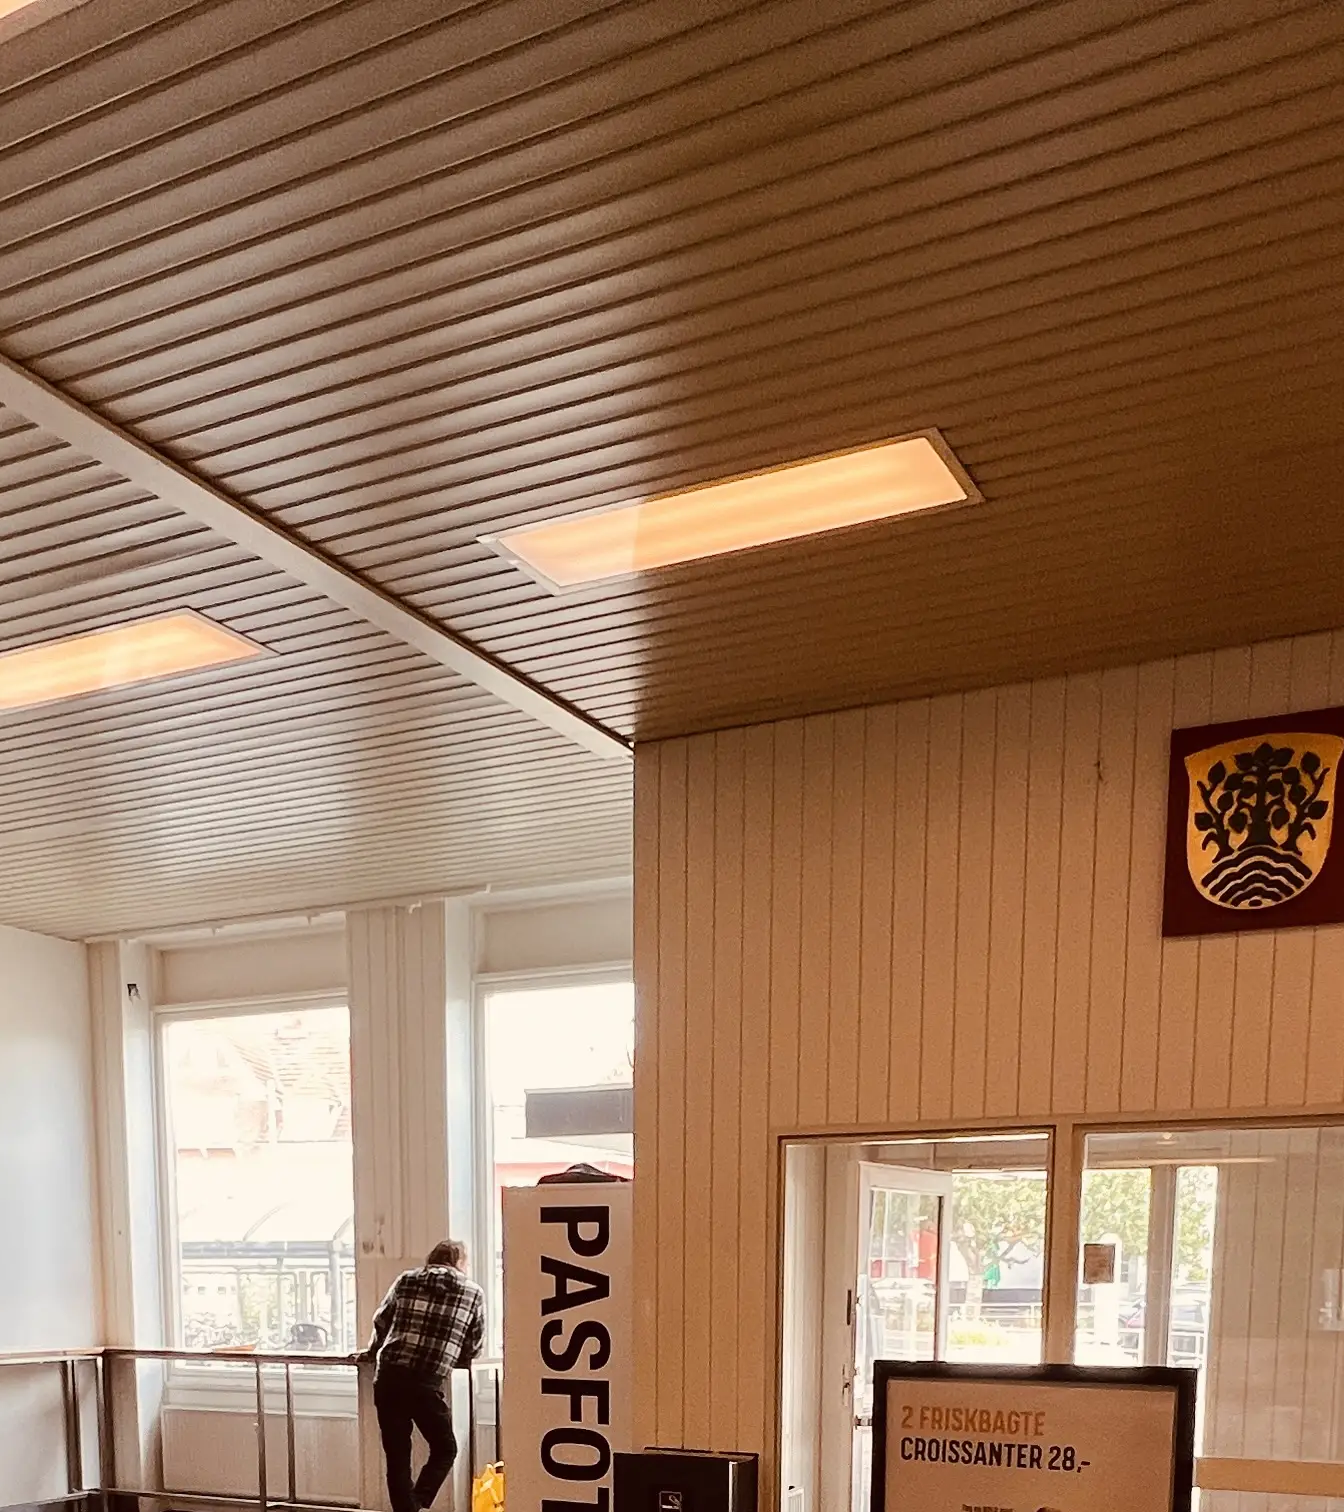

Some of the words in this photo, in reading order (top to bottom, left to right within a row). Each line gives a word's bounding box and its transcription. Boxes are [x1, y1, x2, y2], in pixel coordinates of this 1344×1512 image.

[900, 1404, 914, 1429] 2
[919, 1406, 1047, 1437] FRISKBAGTE
[900, 1436, 1044, 1470] CROISSANTER
[1047, 1445, 1092, 1474] 28,-
